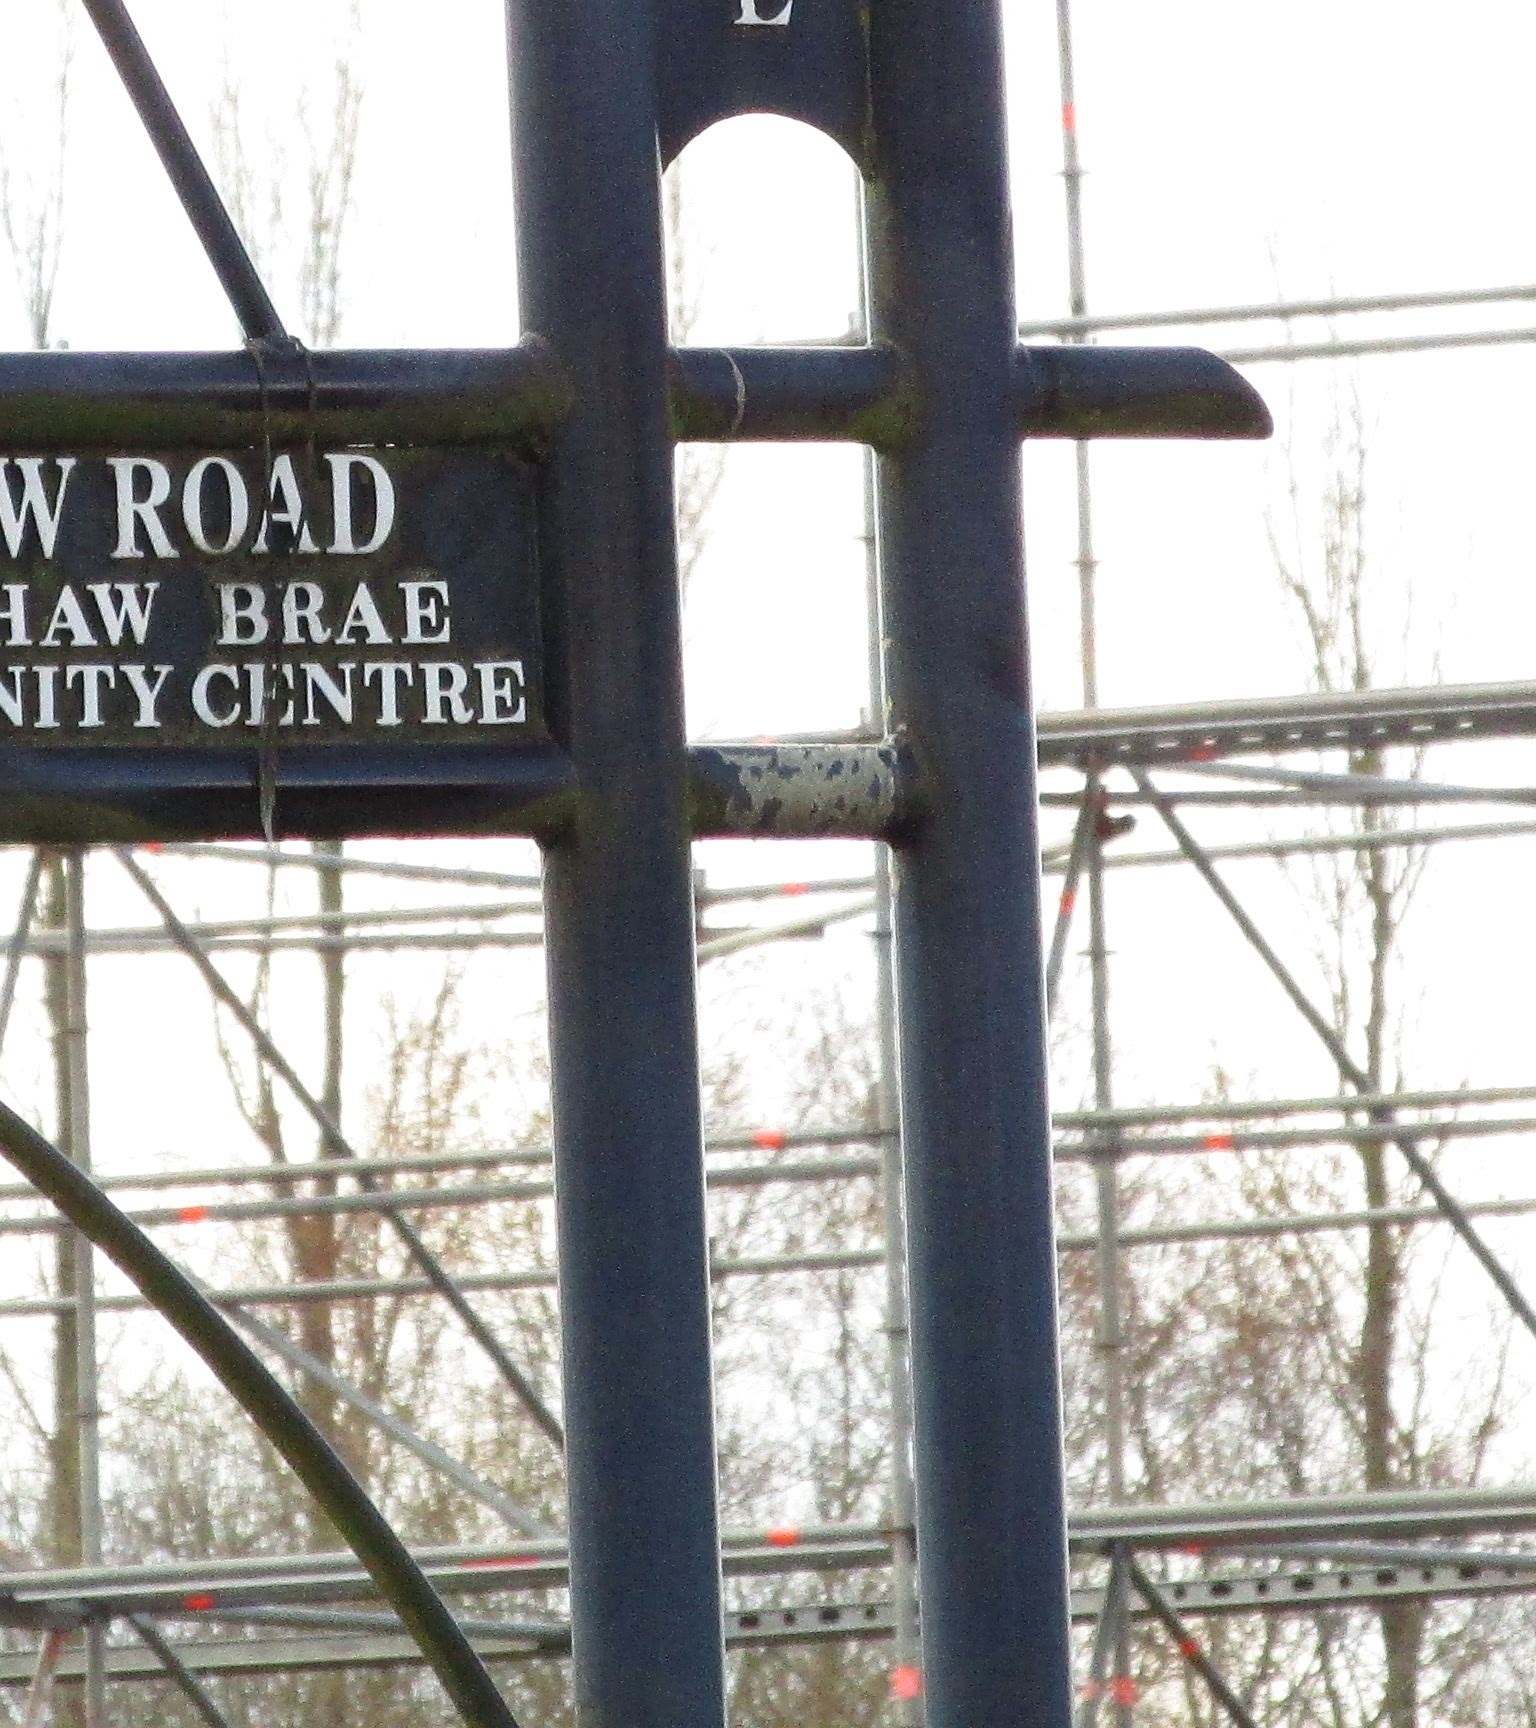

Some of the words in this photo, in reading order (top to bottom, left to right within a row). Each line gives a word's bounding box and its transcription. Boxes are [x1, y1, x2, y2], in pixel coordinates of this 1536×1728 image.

[106, 453, 396, 559] ROAD
[216, 580, 451, 645] BRAE
[191, 659, 527, 728] CENTRE
